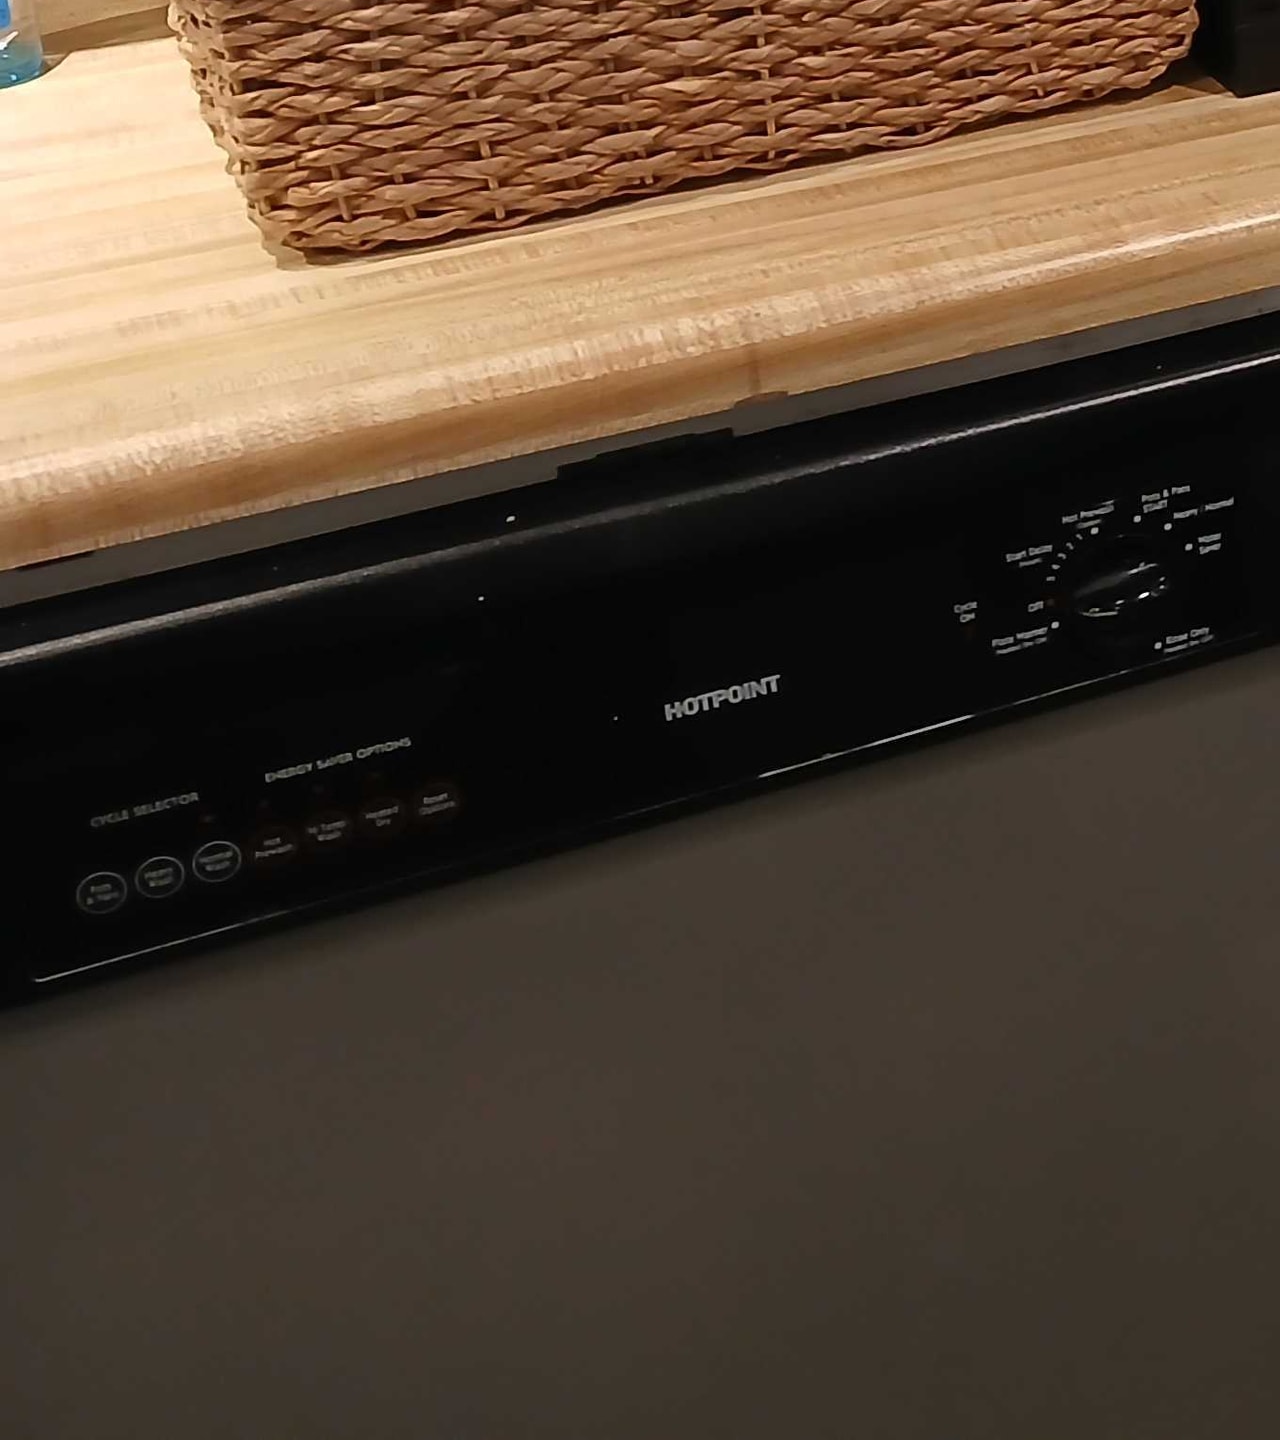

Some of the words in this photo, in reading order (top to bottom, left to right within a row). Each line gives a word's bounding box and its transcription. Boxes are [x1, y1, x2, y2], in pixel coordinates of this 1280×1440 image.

[663, 673, 782, 722] HOTPOINT
[355, 735, 413, 760] OPTIONS
[89, 808, 130, 828] CYCLE
